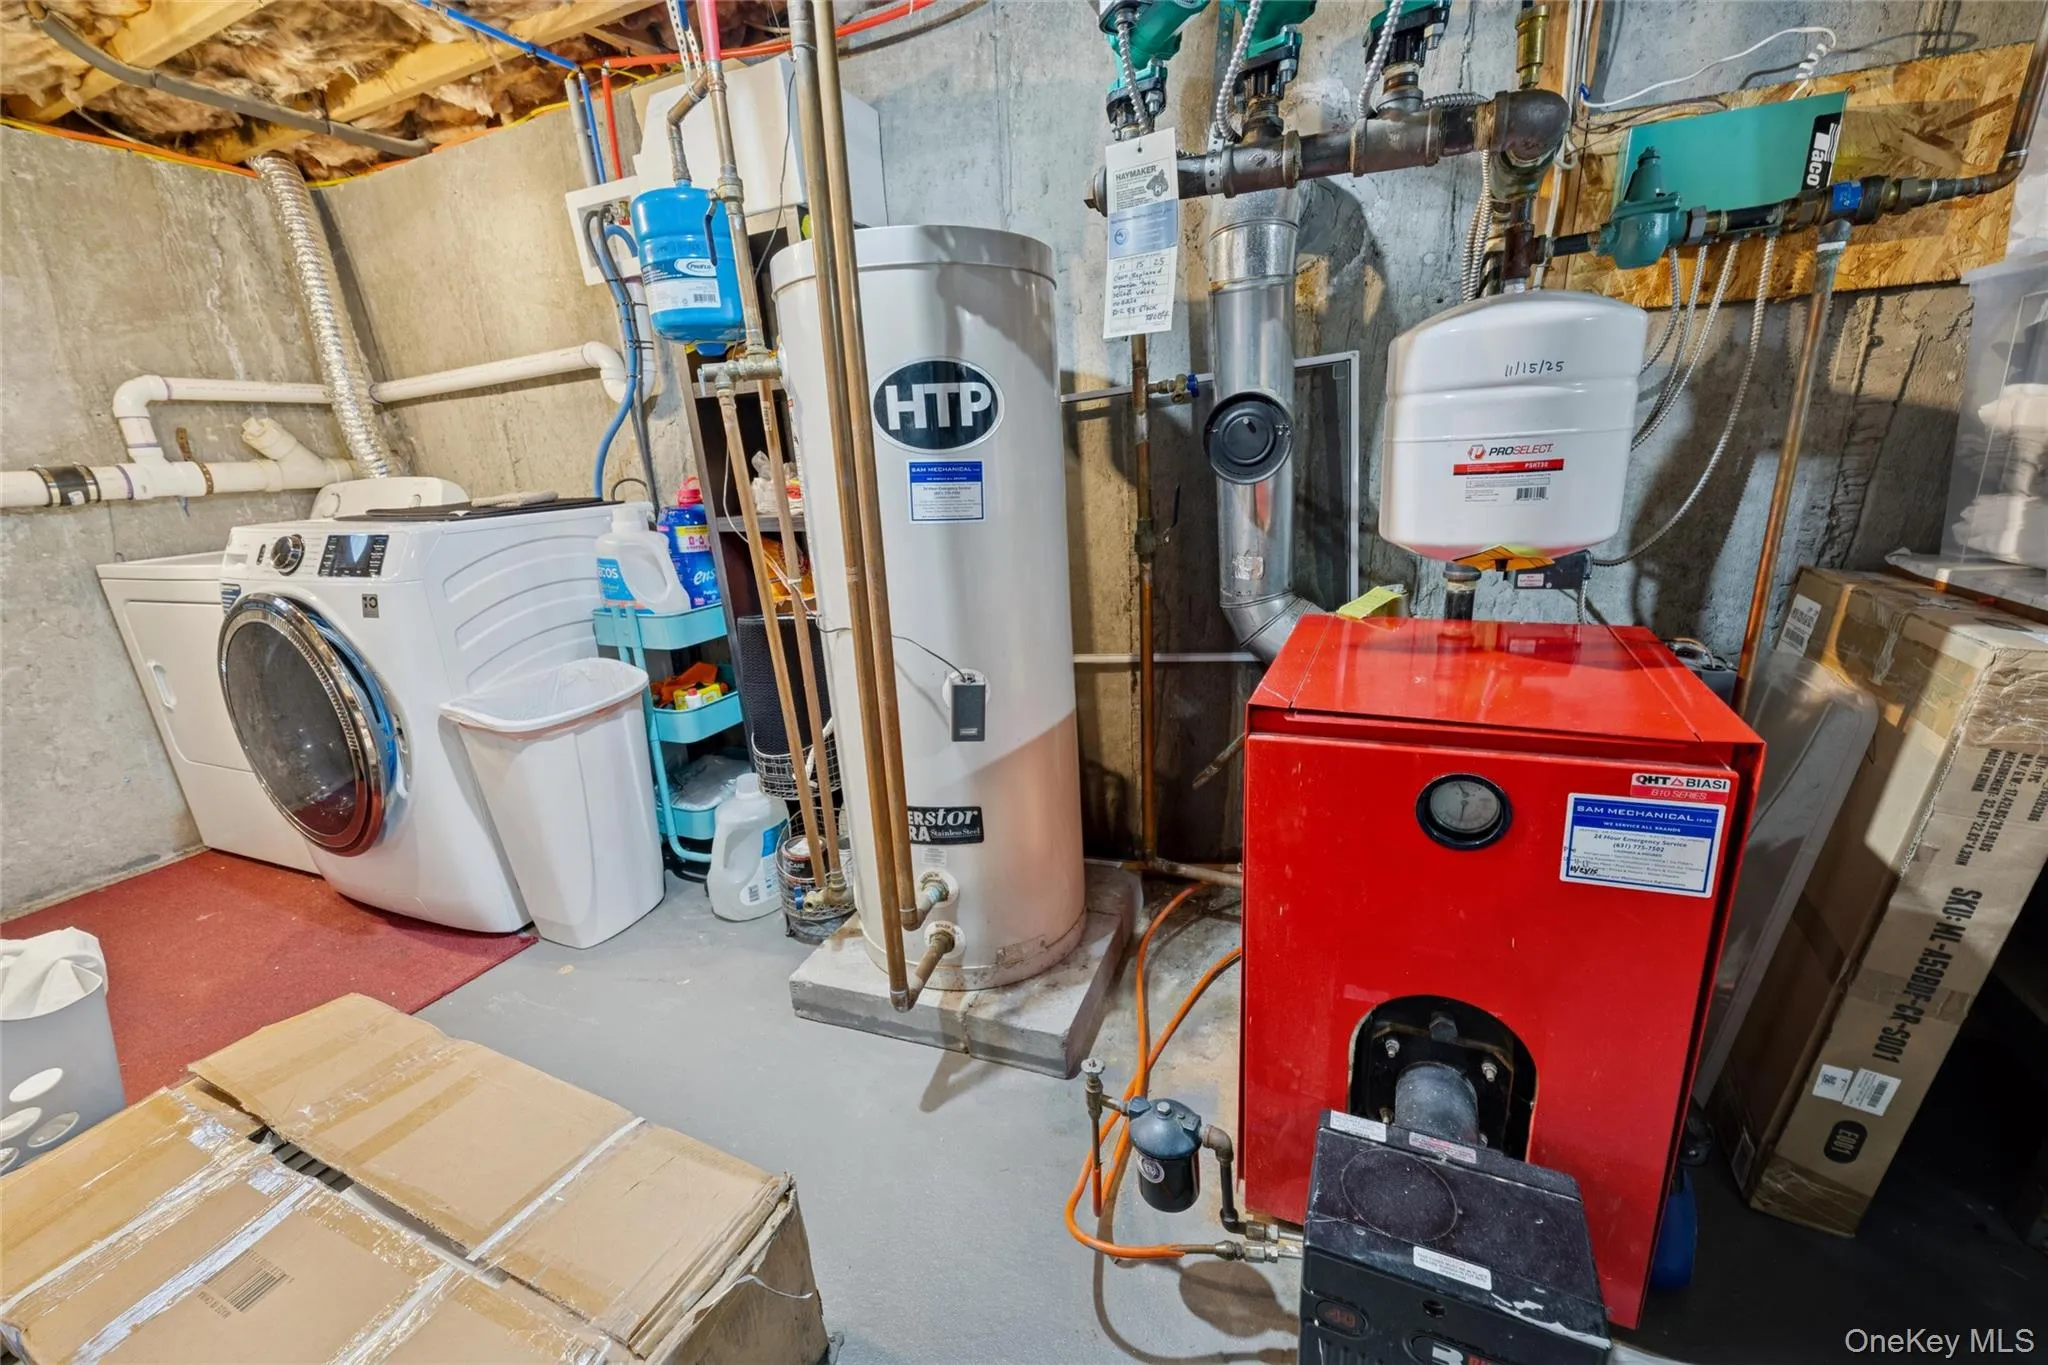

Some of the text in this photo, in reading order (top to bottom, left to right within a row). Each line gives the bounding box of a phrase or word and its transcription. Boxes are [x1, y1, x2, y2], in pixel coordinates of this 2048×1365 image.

[1116, 165, 1157, 180] HAYMAKER
[1504, 360, 1565, 377] 11/15/25
[885, 382, 992, 431] HTP
[1489, 443, 1554, 456] PROSELECT
[1983, 748, 2001, 766] MADE
[1636, 775, 1727, 790] QHT BIASI
[1971, 773, 1990, 792] CHINA
[1672, 790, 1708, 800] SERIES
[1577, 805, 1604, 813] SAM
[1608, 808, 1694, 822] MECHANICAL
[1623, 836, 1660, 845] Emergency
[1942, 887, 1982, 922] SKU:
